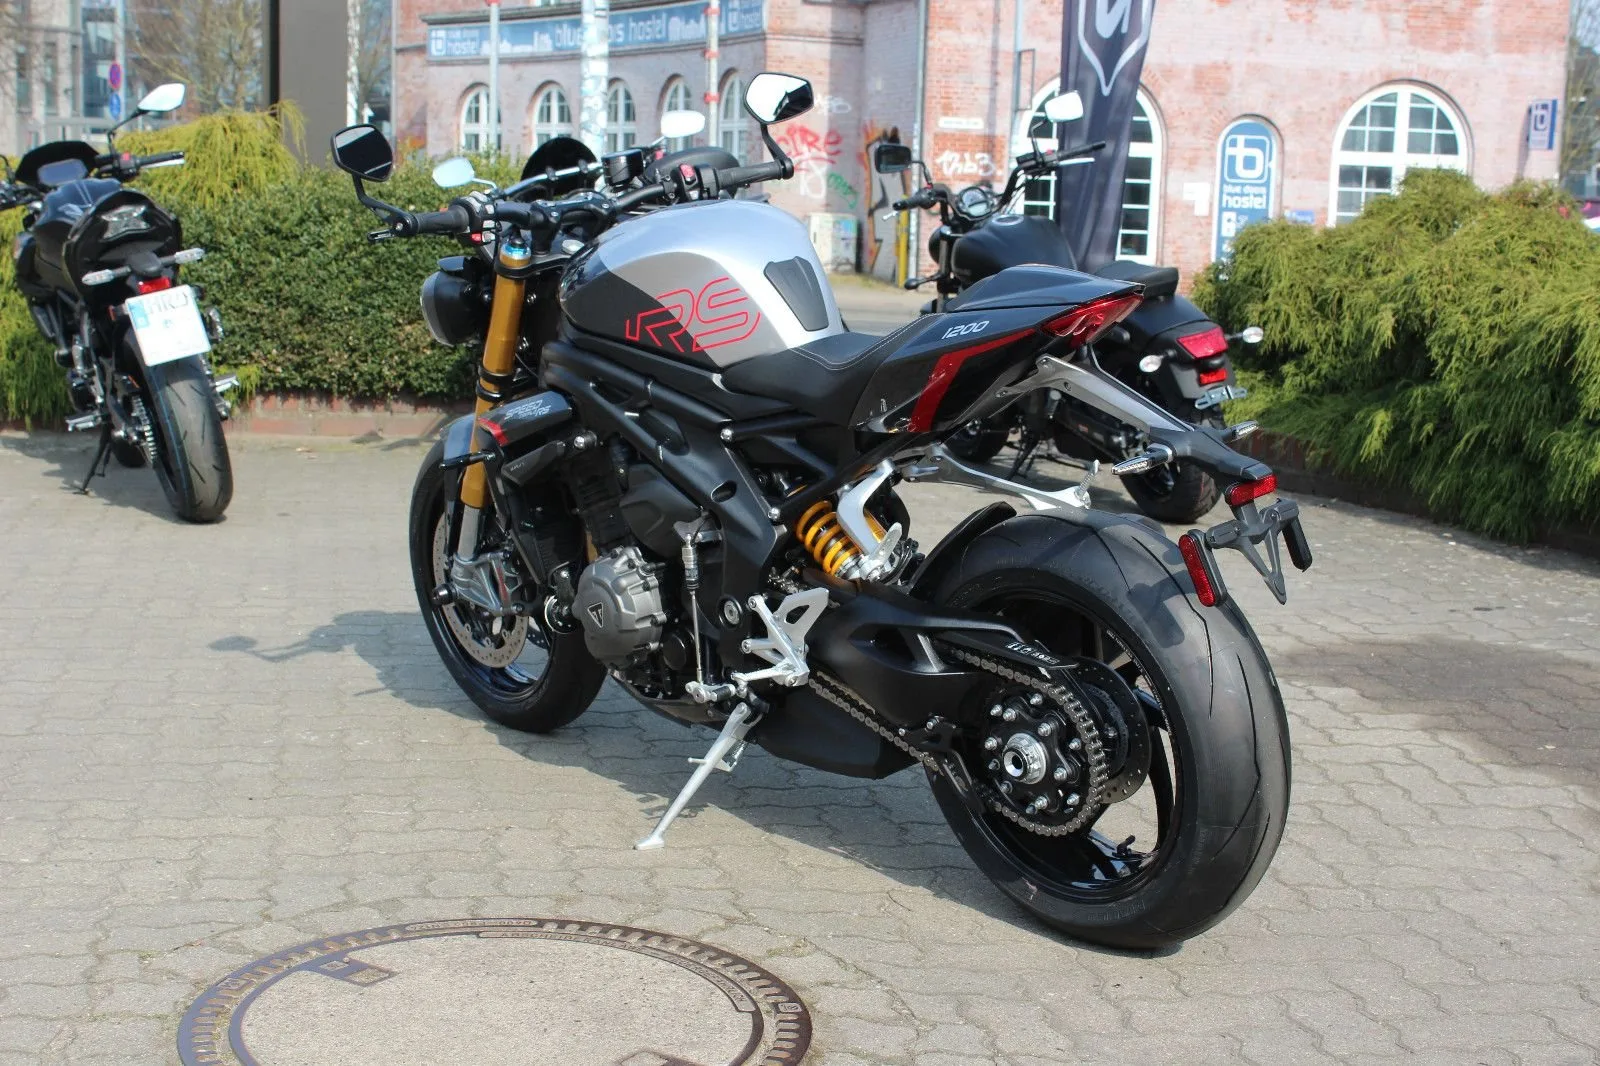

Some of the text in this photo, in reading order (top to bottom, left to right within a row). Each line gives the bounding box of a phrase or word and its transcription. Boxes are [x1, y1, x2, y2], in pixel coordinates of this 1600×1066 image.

[628, 12, 667, 41] hostel
[1221, 193, 1267, 210] hostel
[625, 276, 761, 353] RS
[941, 320, 990, 340] 1200
[504, 399, 543, 420] SPEED
